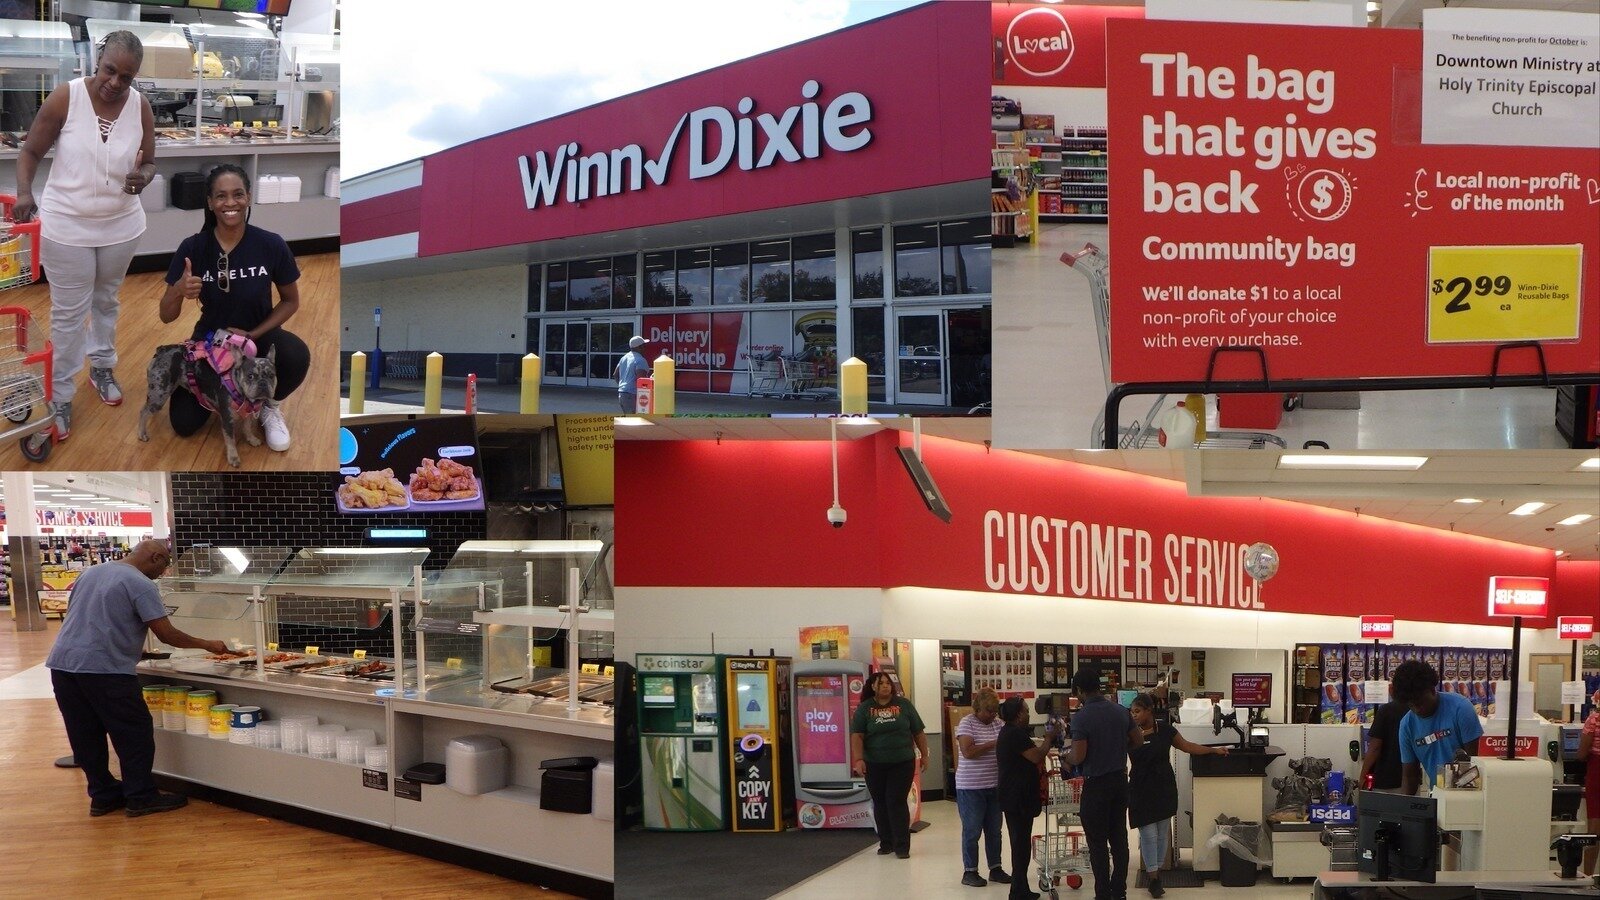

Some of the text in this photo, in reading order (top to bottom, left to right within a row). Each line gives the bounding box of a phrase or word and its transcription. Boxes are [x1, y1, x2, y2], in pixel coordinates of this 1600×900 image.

[1452, 33, 1465, 41] The
[1466, 34, 1501, 43] benefiting
[1502, 36, 1537, 45] non-profit
[1549, 37, 1579, 46] October
[1436, 53, 1600, 74] Downtown Ministry at
[1139, 51, 1335, 115] The bag
[1439, 77, 1596, 97] Holy Trinity Episcopal
[1491, 101, 1543, 116] Church
[517, 79, 873, 210] Winn Dixie
[1142, 110, 1377, 171] that gives
[1435, 171, 1581, 193] Local non-profit
[1143, 168, 1261, 214] back
[1450, 193, 1565, 211] of the month
[1142, 235, 1356, 267] Community bag
[1142, 284, 1342, 302] We'll donate $1 to a local
[1517, 284, 1560, 292] Winn-Dixie
[1552, 292, 1570, 301] Bags
[1500, 303, 1512, 311] ea
[1142, 308, 1337, 327] non-profit of your choice
[650, 326, 710, 347] Delvery
[1142, 331, 1303, 348] with every purchase.
[765, 343, 785, 352] online
[565, 415, 608, 424] Processed
[397, 427, 417, 441] Flavors
[566, 426, 592, 434] frozen
[567, 434, 598, 444] highest
[568, 442, 594, 451] safety
[984, 509, 1153, 601] CUSTOMER
[656, 657, 704, 669] coinstar
[805, 707, 833, 723] play
[810, 720, 838, 732] here
[1485, 736, 1508, 747] Card
[738, 780, 771, 798] COPY
[742, 802, 768, 820] KEY
[828, 815, 850, 826] PLAY
[850, 811, 870, 821] HERE
[1311, 808, 1351, 820] PEPSI
